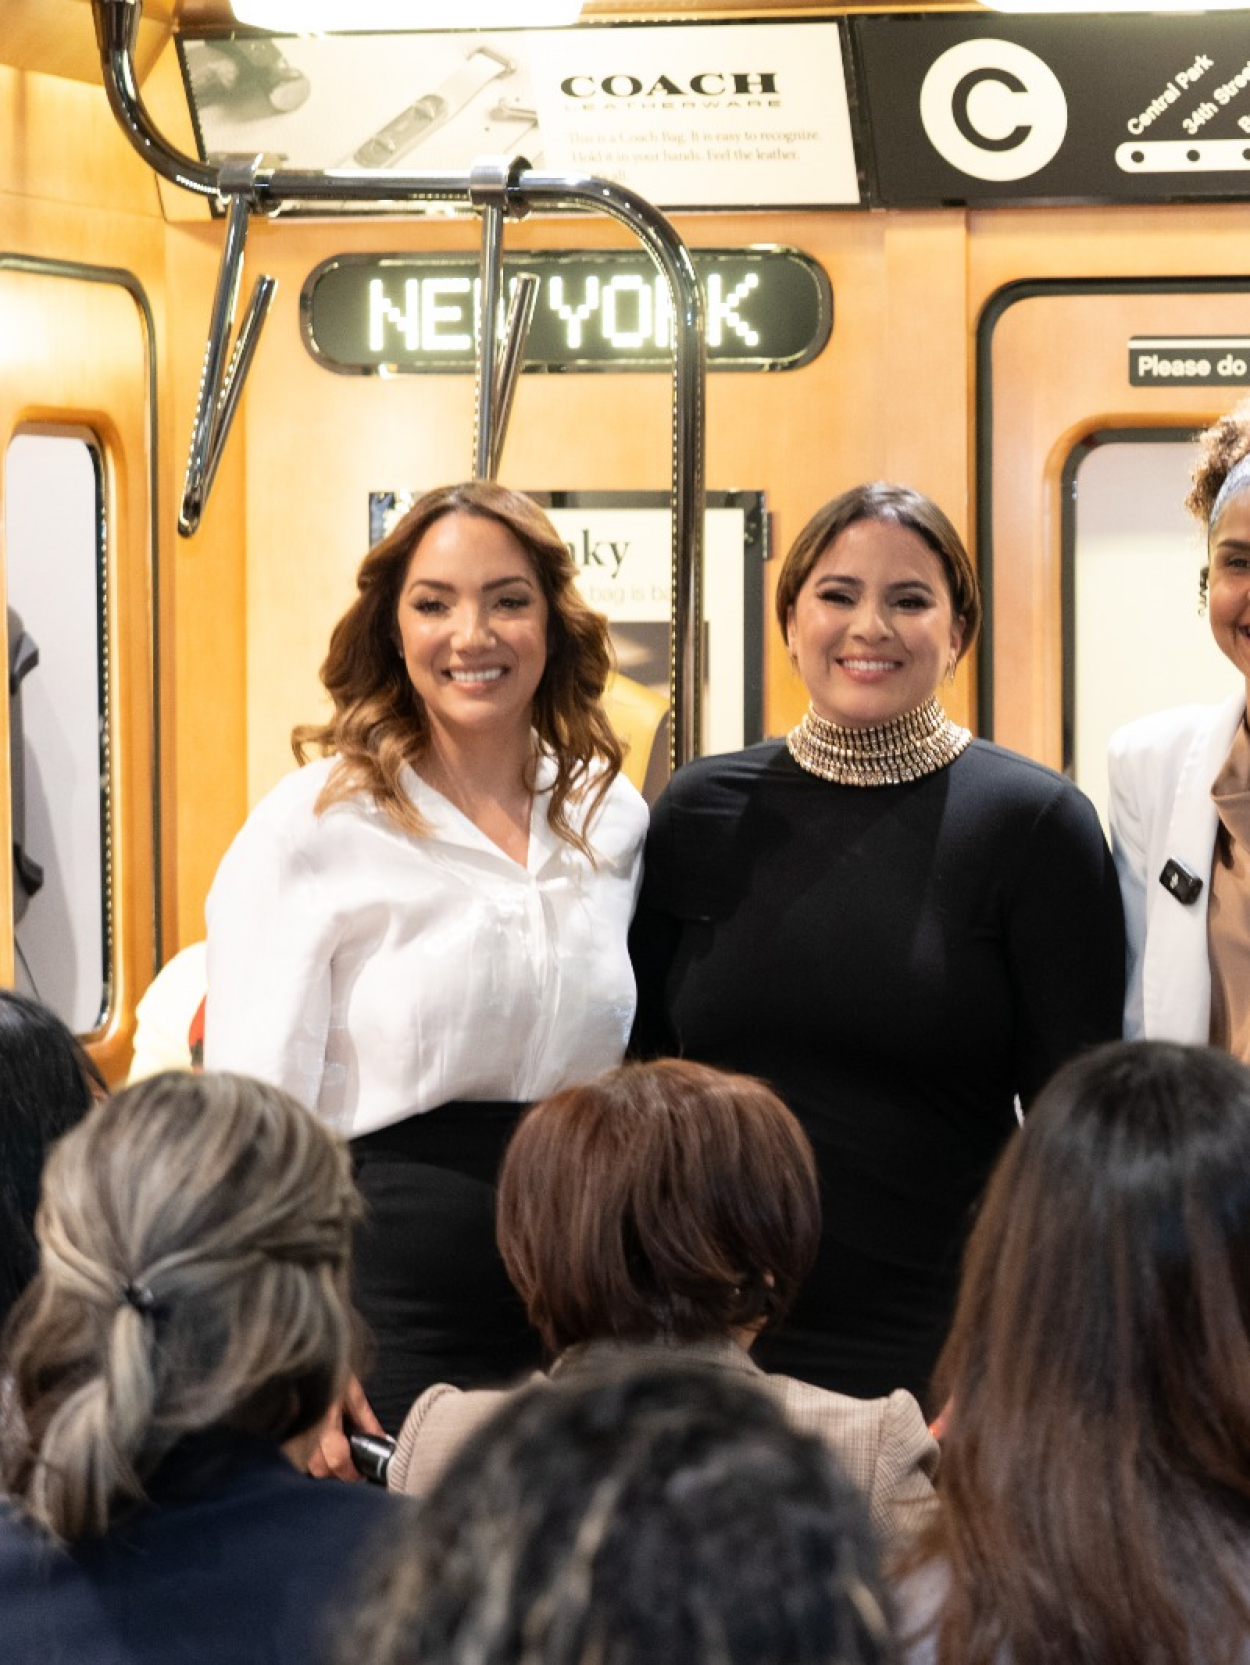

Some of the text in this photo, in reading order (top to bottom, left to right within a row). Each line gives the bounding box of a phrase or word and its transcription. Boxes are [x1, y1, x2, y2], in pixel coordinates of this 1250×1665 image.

[559, 72, 780, 98] COACH
[1127, 53, 1215, 135] Central Park
[951, 66, 1033, 152] C
[1182, 102, 1220, 135] 34th
[1137, 353, 1248, 377] Please do
